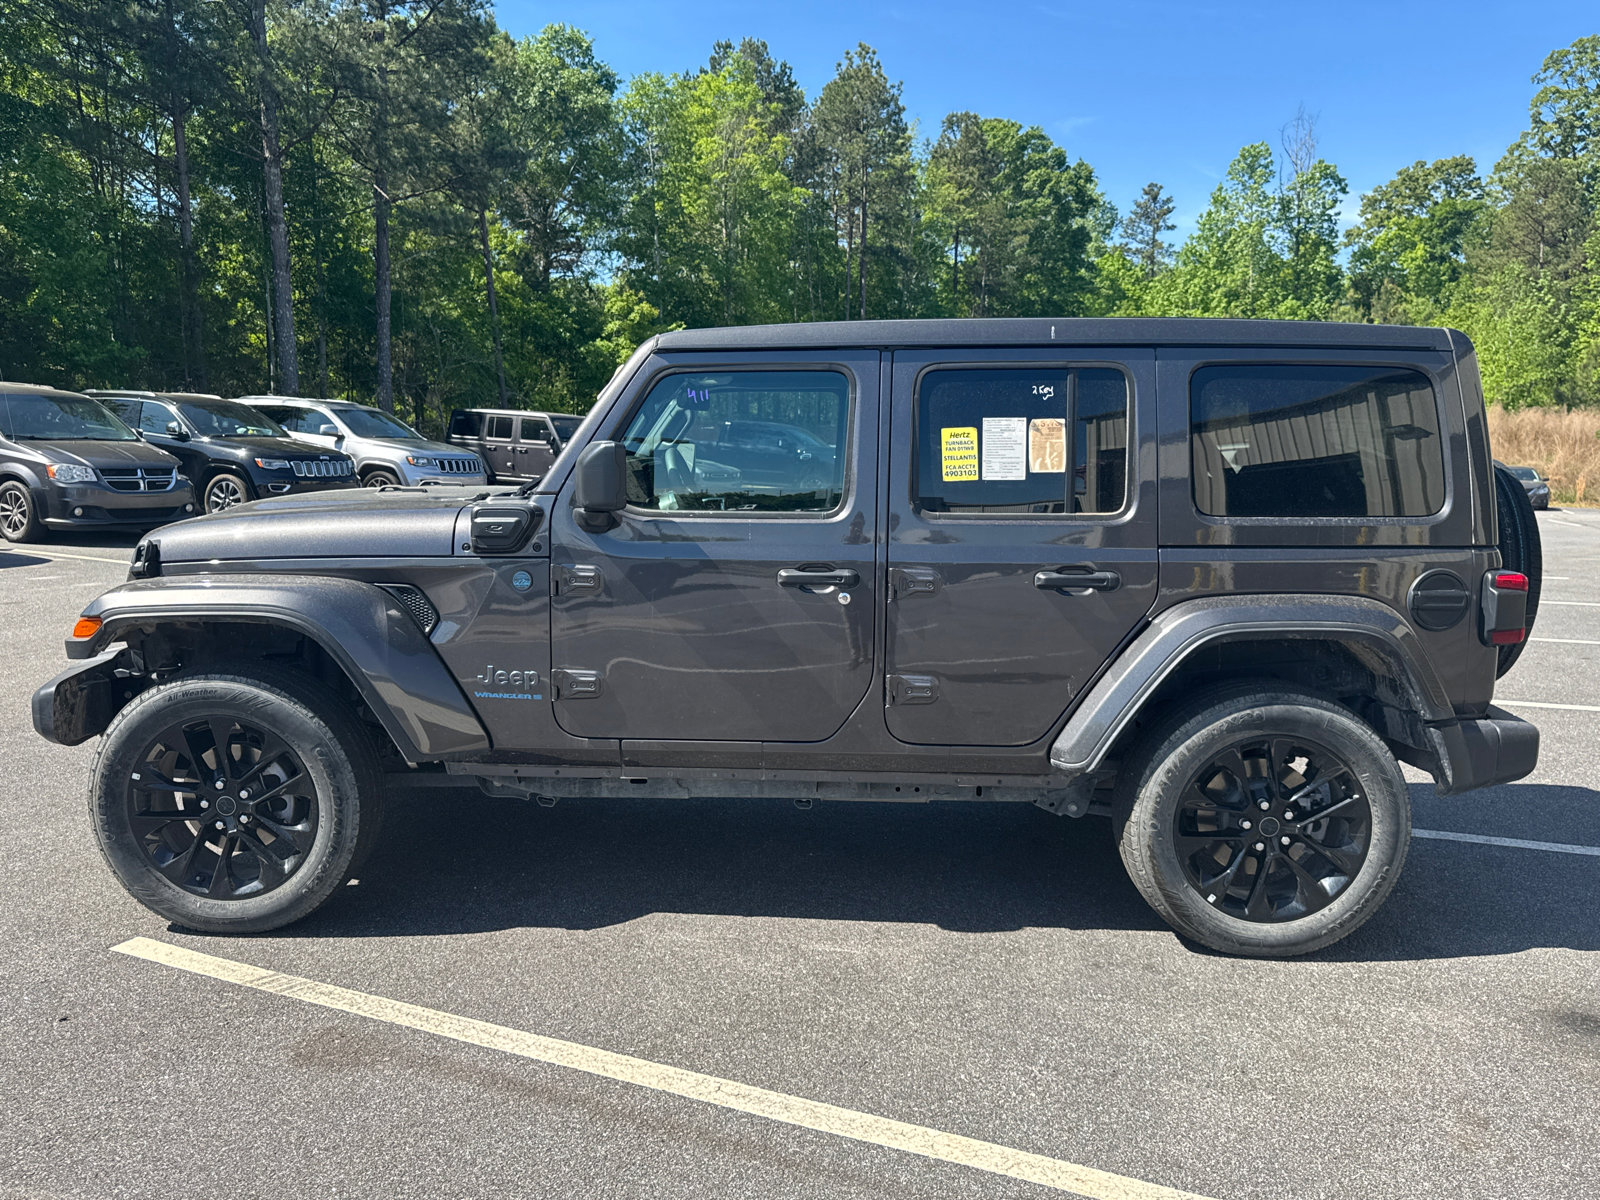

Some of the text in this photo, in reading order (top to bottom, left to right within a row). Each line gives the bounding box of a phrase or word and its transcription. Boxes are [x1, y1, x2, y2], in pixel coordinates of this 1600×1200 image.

[1032, 385, 1038, 395] 2
[949, 431, 971, 439] Hertz
[477, 664, 539, 690] Jeep
[168, 688, 218, 703] All-Weather
[474, 691, 532, 700] WRANGLER
